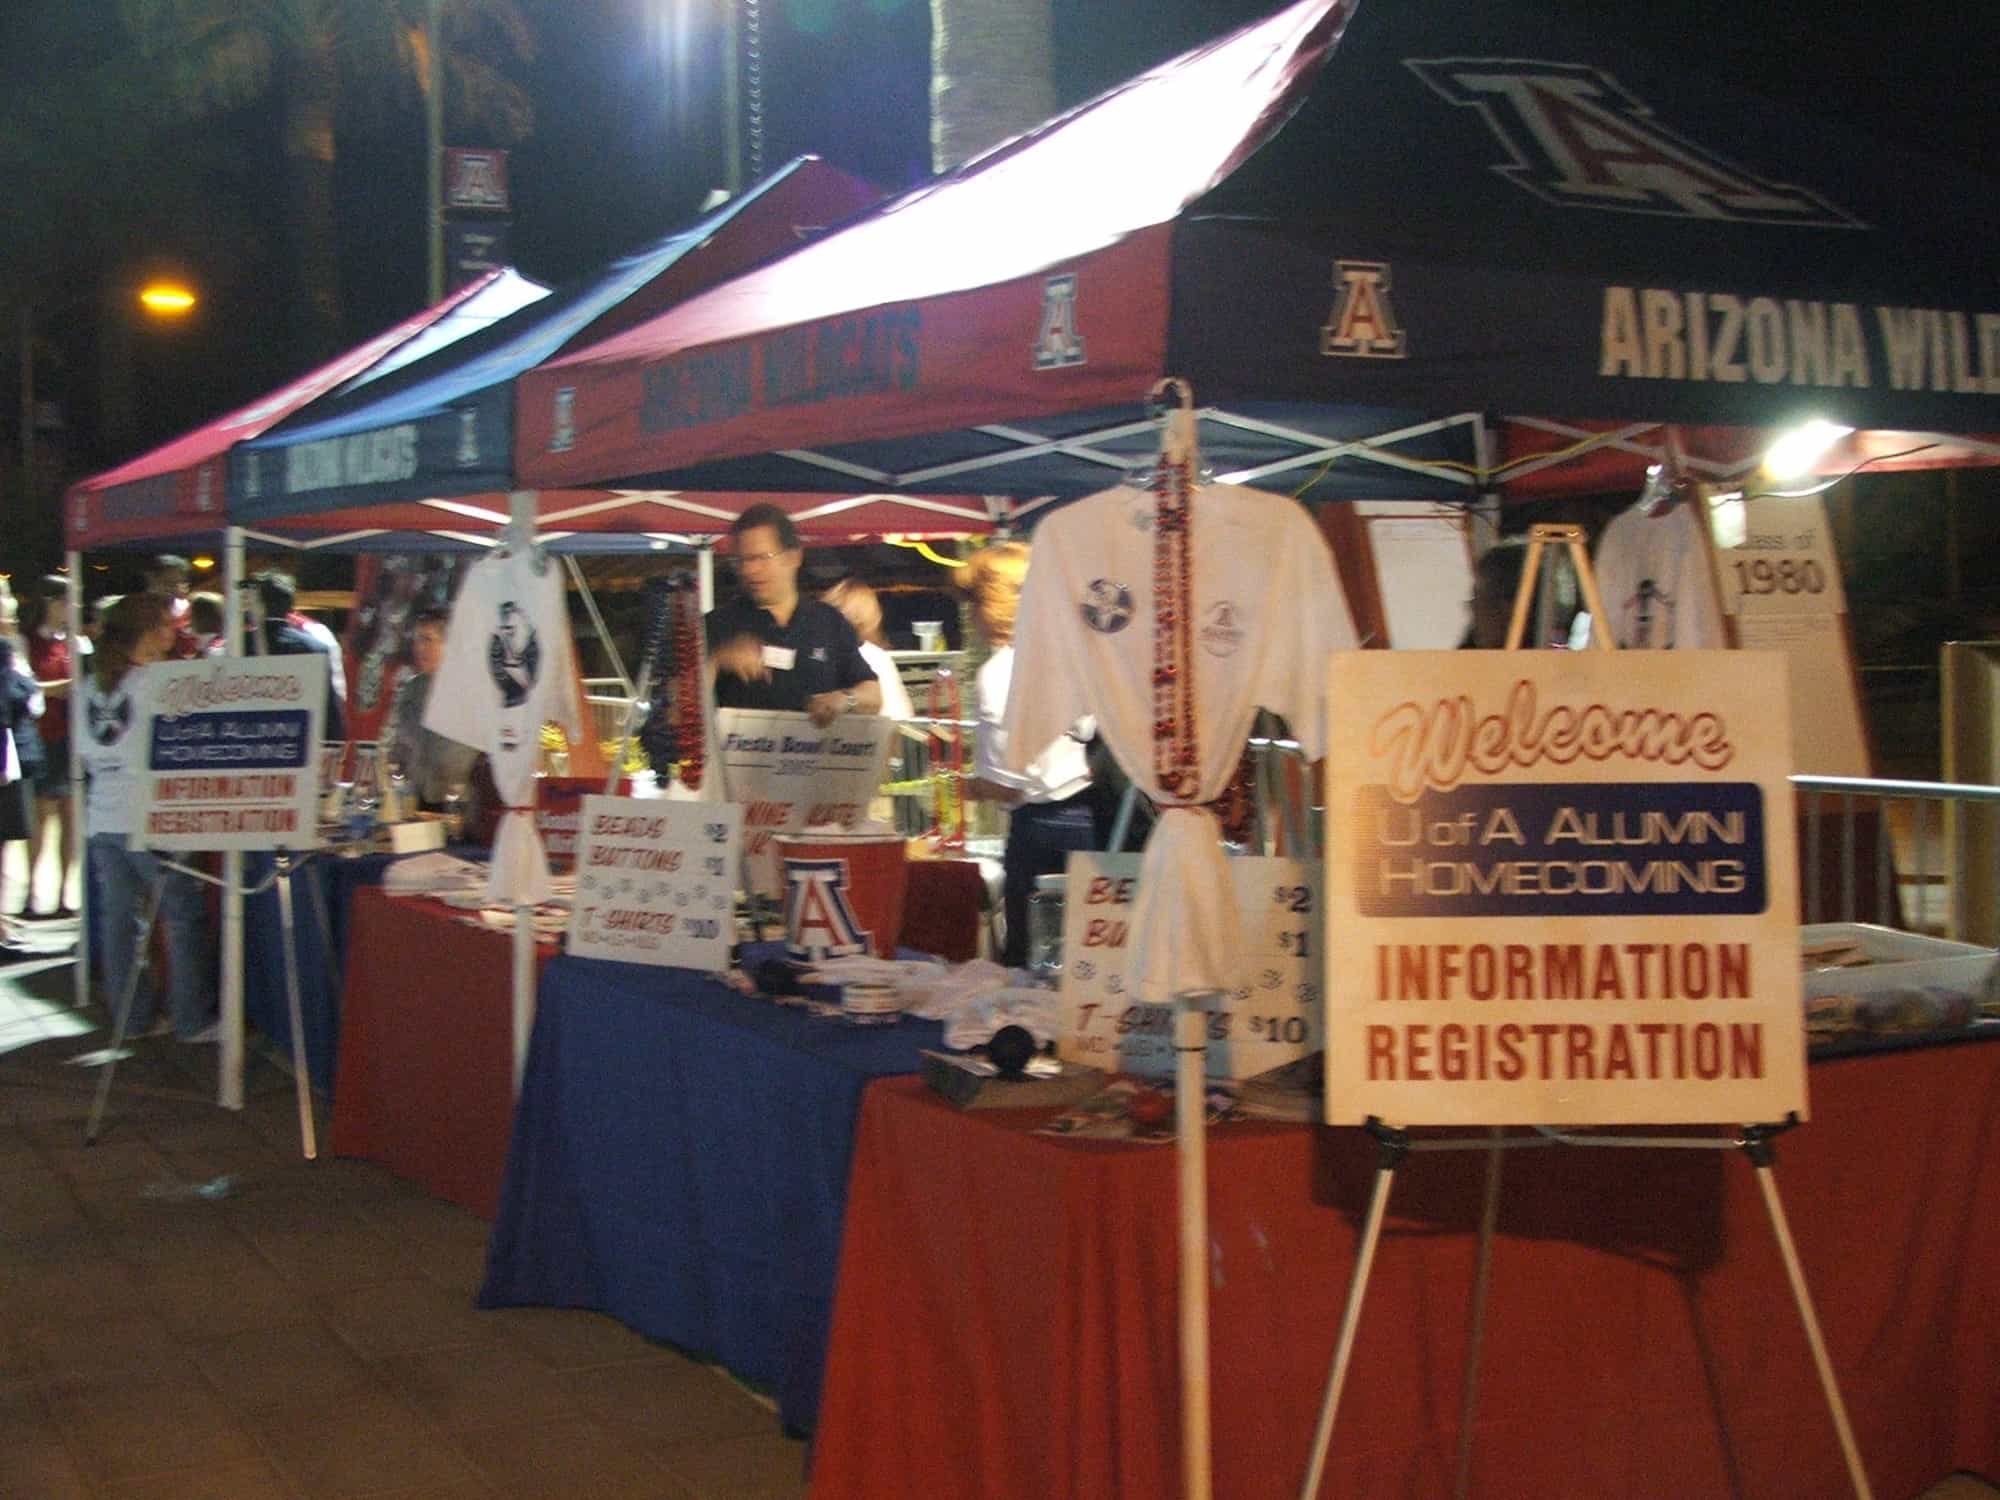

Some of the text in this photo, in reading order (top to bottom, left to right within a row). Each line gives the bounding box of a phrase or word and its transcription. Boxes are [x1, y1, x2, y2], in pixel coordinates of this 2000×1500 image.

[1320, 260, 1407, 358] A
[1599, 285, 1872, 387] ARIZONA
[1730, 559, 1825, 594] 1980
[1371, 679, 1736, 803] Welcome
[1379, 806, 1744, 847] U of A ALUMNI
[1274, 885, 1313, 914] $2
[1379, 859, 1744, 895] HOMECOMING
[784, 857, 873, 966] A
[1376, 942, 1752, 1001] INFORMATION
[1248, 1014, 1310, 1044] $10
[1365, 1021, 1767, 1081] REGISTRATION
